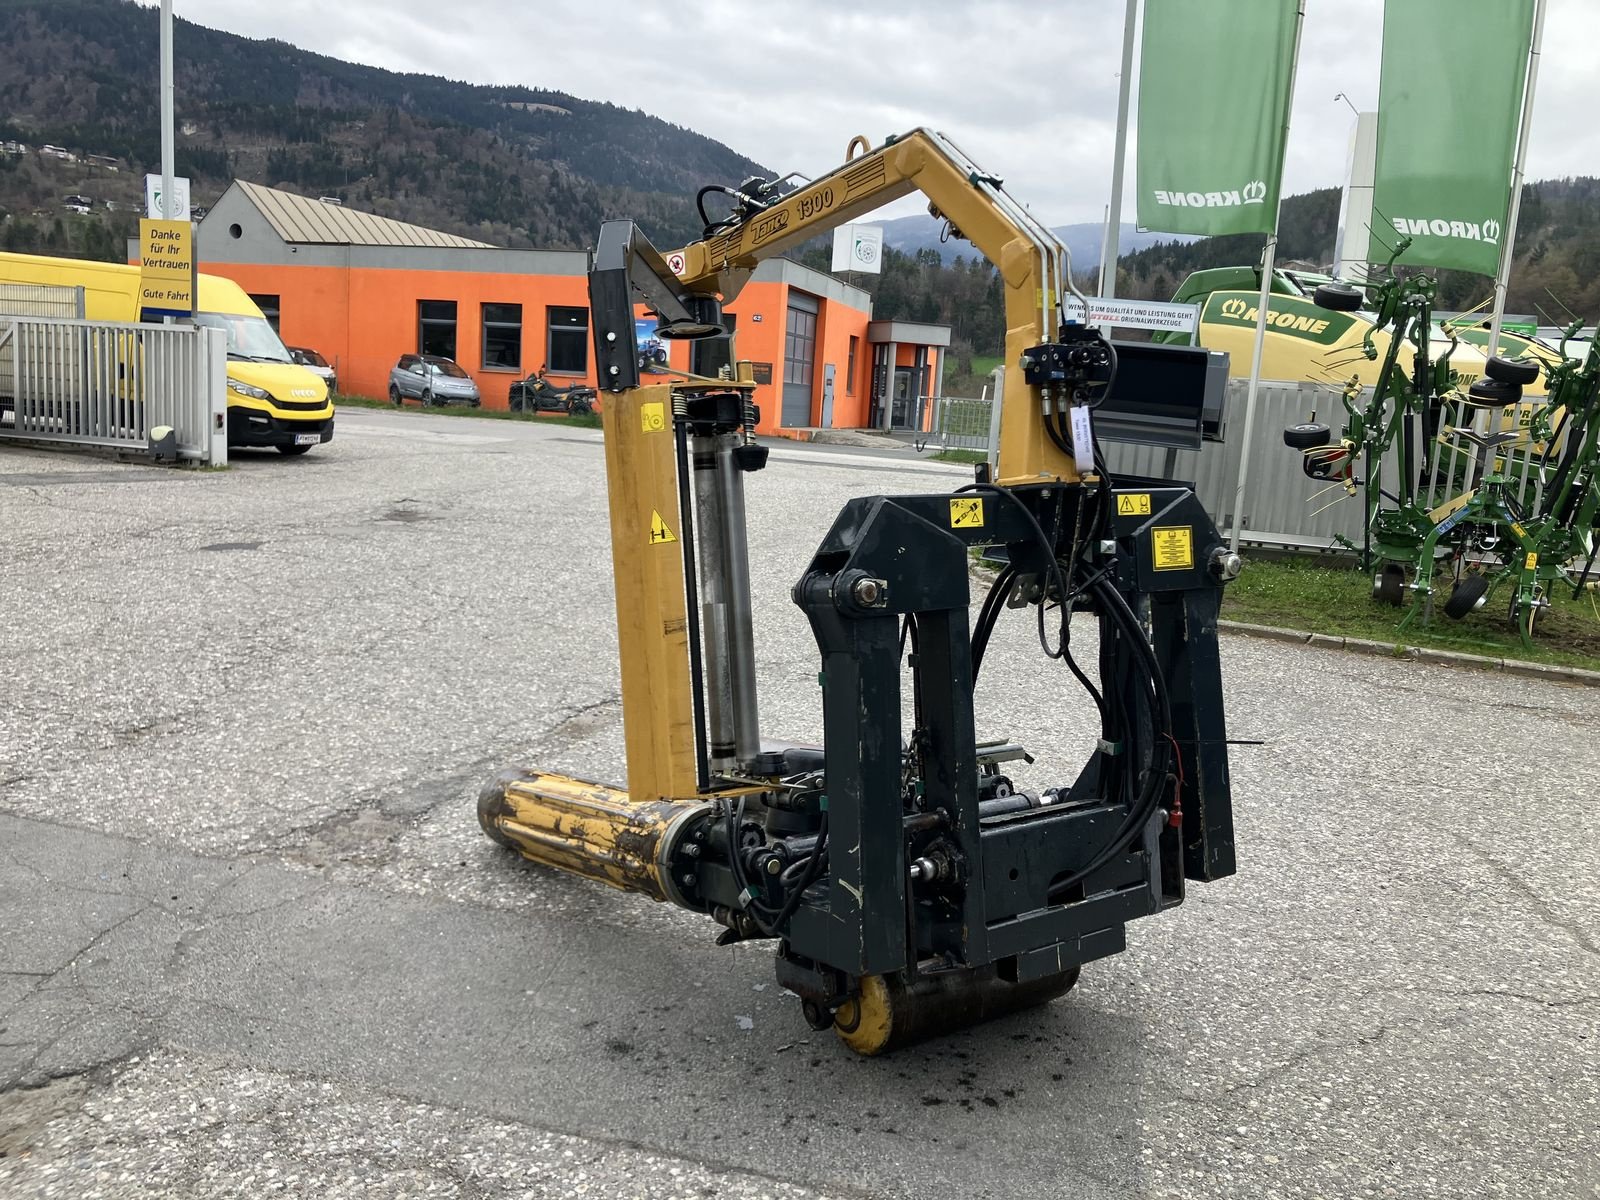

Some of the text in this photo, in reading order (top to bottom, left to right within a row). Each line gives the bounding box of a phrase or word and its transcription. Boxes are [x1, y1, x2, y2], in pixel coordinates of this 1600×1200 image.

[797, 187, 834, 220] 1300
[751, 209, 789, 244] Tanco
[151, 229, 181, 240] Danke
[150, 243, 181, 255] für Ihr
[143, 257, 190, 270] Vertrauen
[143, 288, 189, 301] Gute Fahrt
[1090, 313, 1120, 321] STOLL
[1147, 310, 1177, 319] LEISTUNG
[1243, 307, 1330, 334] KRONE
